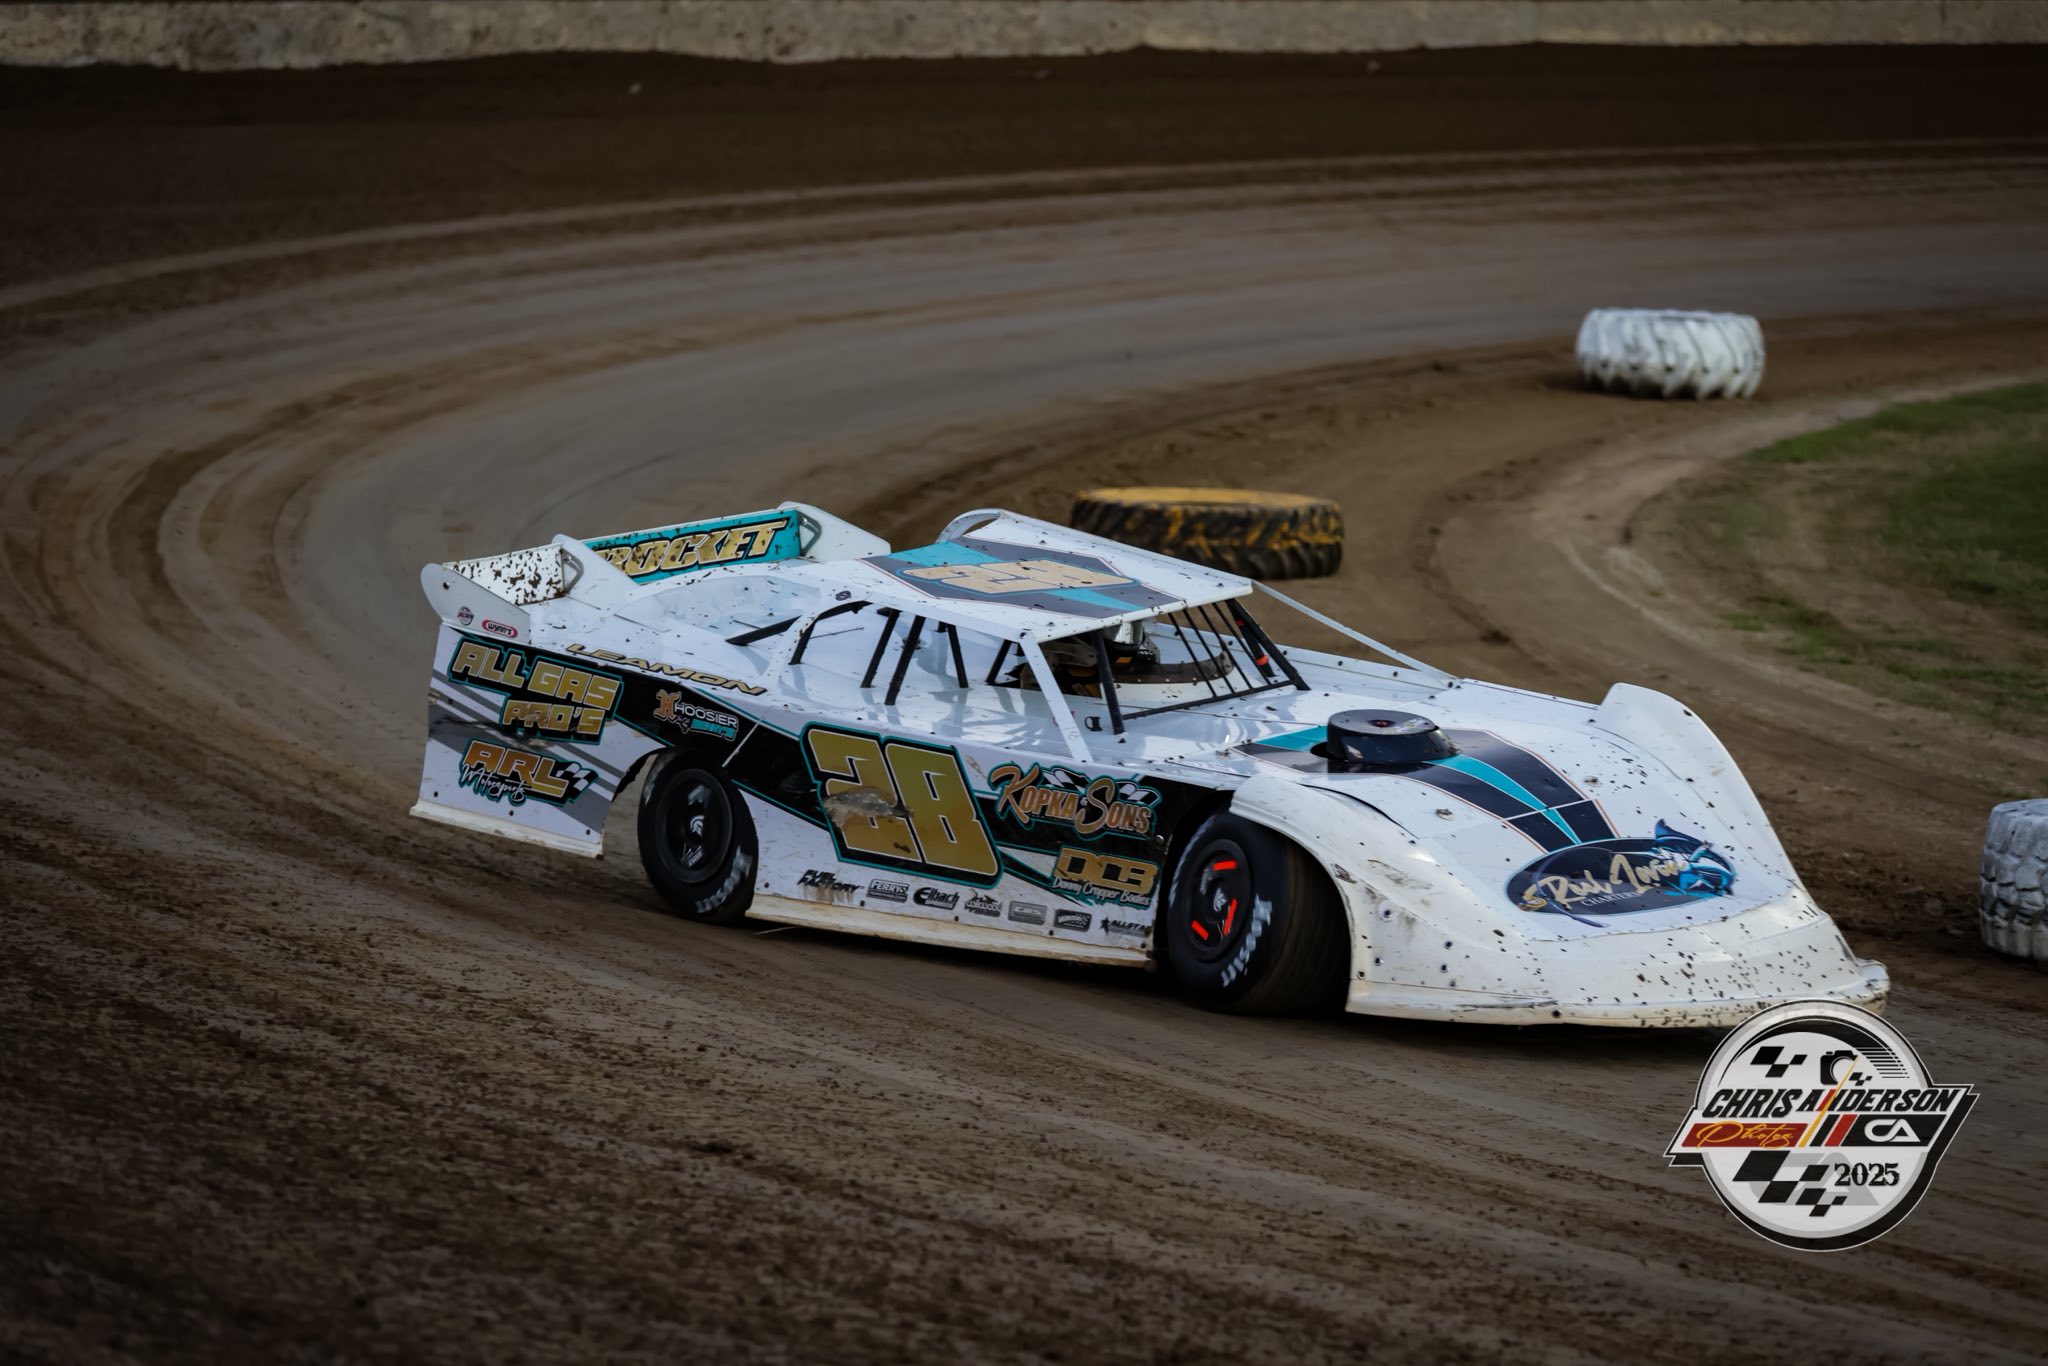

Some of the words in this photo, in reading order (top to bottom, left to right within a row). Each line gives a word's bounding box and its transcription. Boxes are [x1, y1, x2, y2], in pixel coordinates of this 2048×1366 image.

[452, 641, 525, 688] ALL
[527, 661, 620, 711] GAS
[566, 643, 768, 696] LEAMON
[502, 699, 606, 735] PRO'S
[674, 702, 738, 728] HOOSIER
[463, 740, 569, 798] ARL
[808, 729, 998, 876] 28
[797, 876, 862, 893] FACTORY
[804, 869, 838, 882] FUEL
